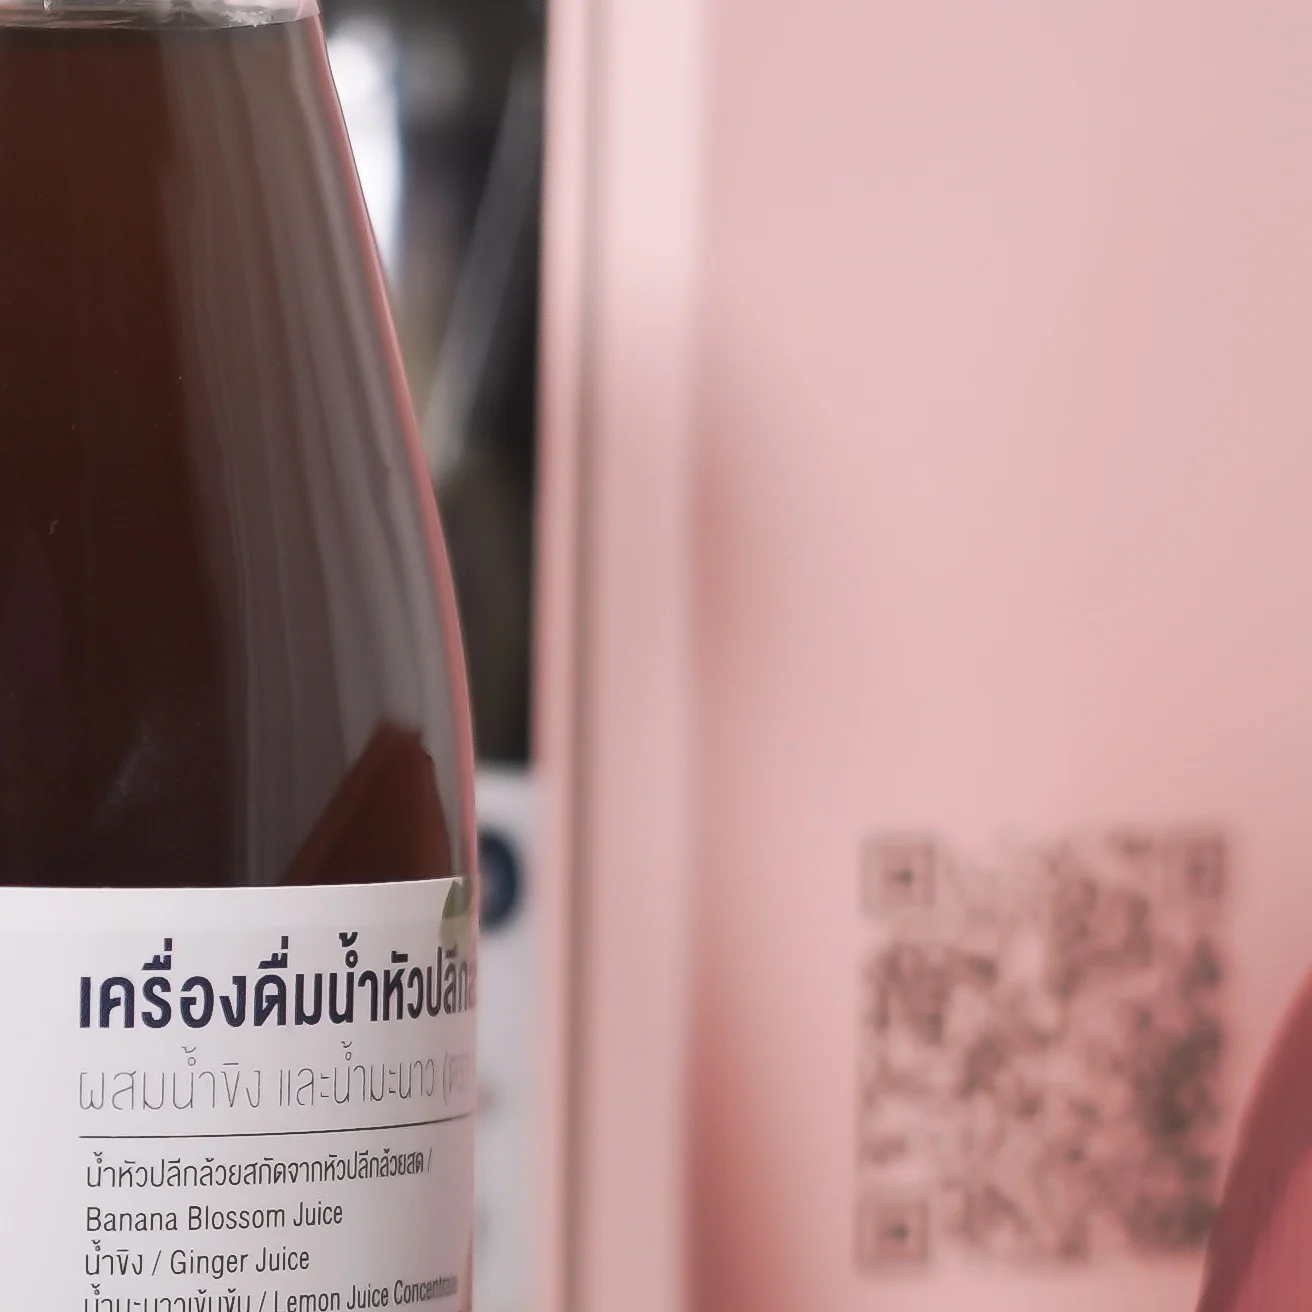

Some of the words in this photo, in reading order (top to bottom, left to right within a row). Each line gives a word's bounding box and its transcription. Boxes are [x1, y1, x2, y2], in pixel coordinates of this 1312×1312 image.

[79, 932, 474, 1029] เครื่องดื่มน้ำหัวปลีก
[79, 1045, 261, 1110] ผสมน้ำขิง
[279, 1041, 435, 1107] และน้ำมะนาว
[86, 1207, 178, 1232] Banana
[188, 1204, 285, 1230] Blossom
[293, 1202, 343, 1226] Juice
[84, 1239, 143, 1276] น้ำขิง
[170, 1249, 249, 1279] Ginger
[255, 1246, 310, 1273] Juice
[347, 1284, 389, 1312] Juice
